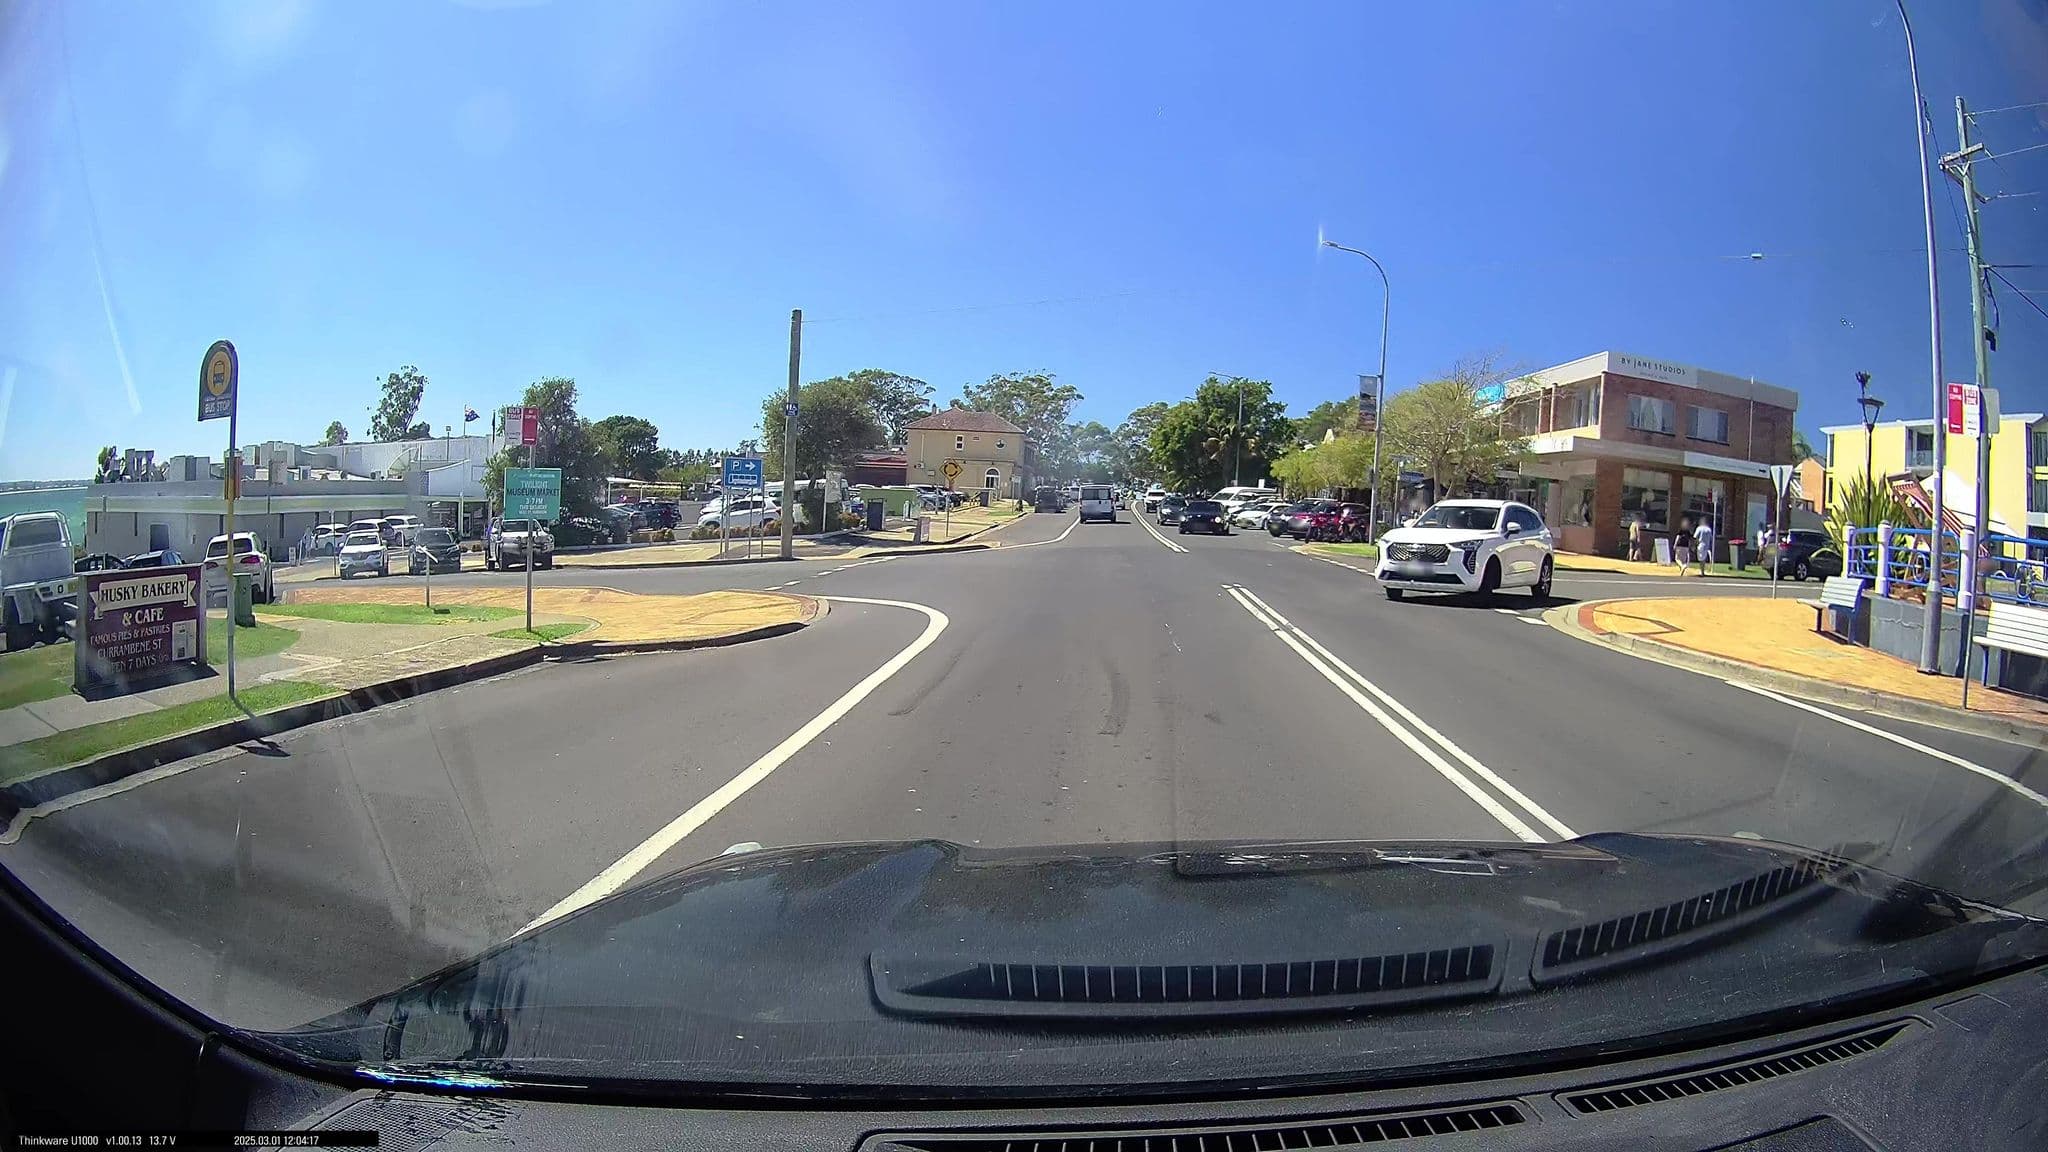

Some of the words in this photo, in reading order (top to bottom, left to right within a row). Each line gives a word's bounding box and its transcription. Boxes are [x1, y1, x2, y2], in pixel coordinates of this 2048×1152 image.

[1621, 357, 1631, 365] BY
[1633, 359, 1651, 369] JANE
[1655, 363, 1686, 375] STUDIOS
[507, 488, 536, 497] MUSEUM
[537, 488, 560, 497] MARKET
[521, 480, 548, 488] TWILIGHT
[100, 585, 139, 603] HUSKY
[141, 580, 187, 598] BAKERY
[122, 611, 133, 626] &
[134, 607, 165, 625] CAFE
[90, 631, 118, 645] FAMOUS
[118, 629, 133, 642] PIES
[133, 627, 141, 639] &
[97, 639, 152, 660] CURRAMBENE
[152, 638, 164, 650] ST
[128, 659, 134, 670] 7
[135, 654, 158, 670] DAYS
